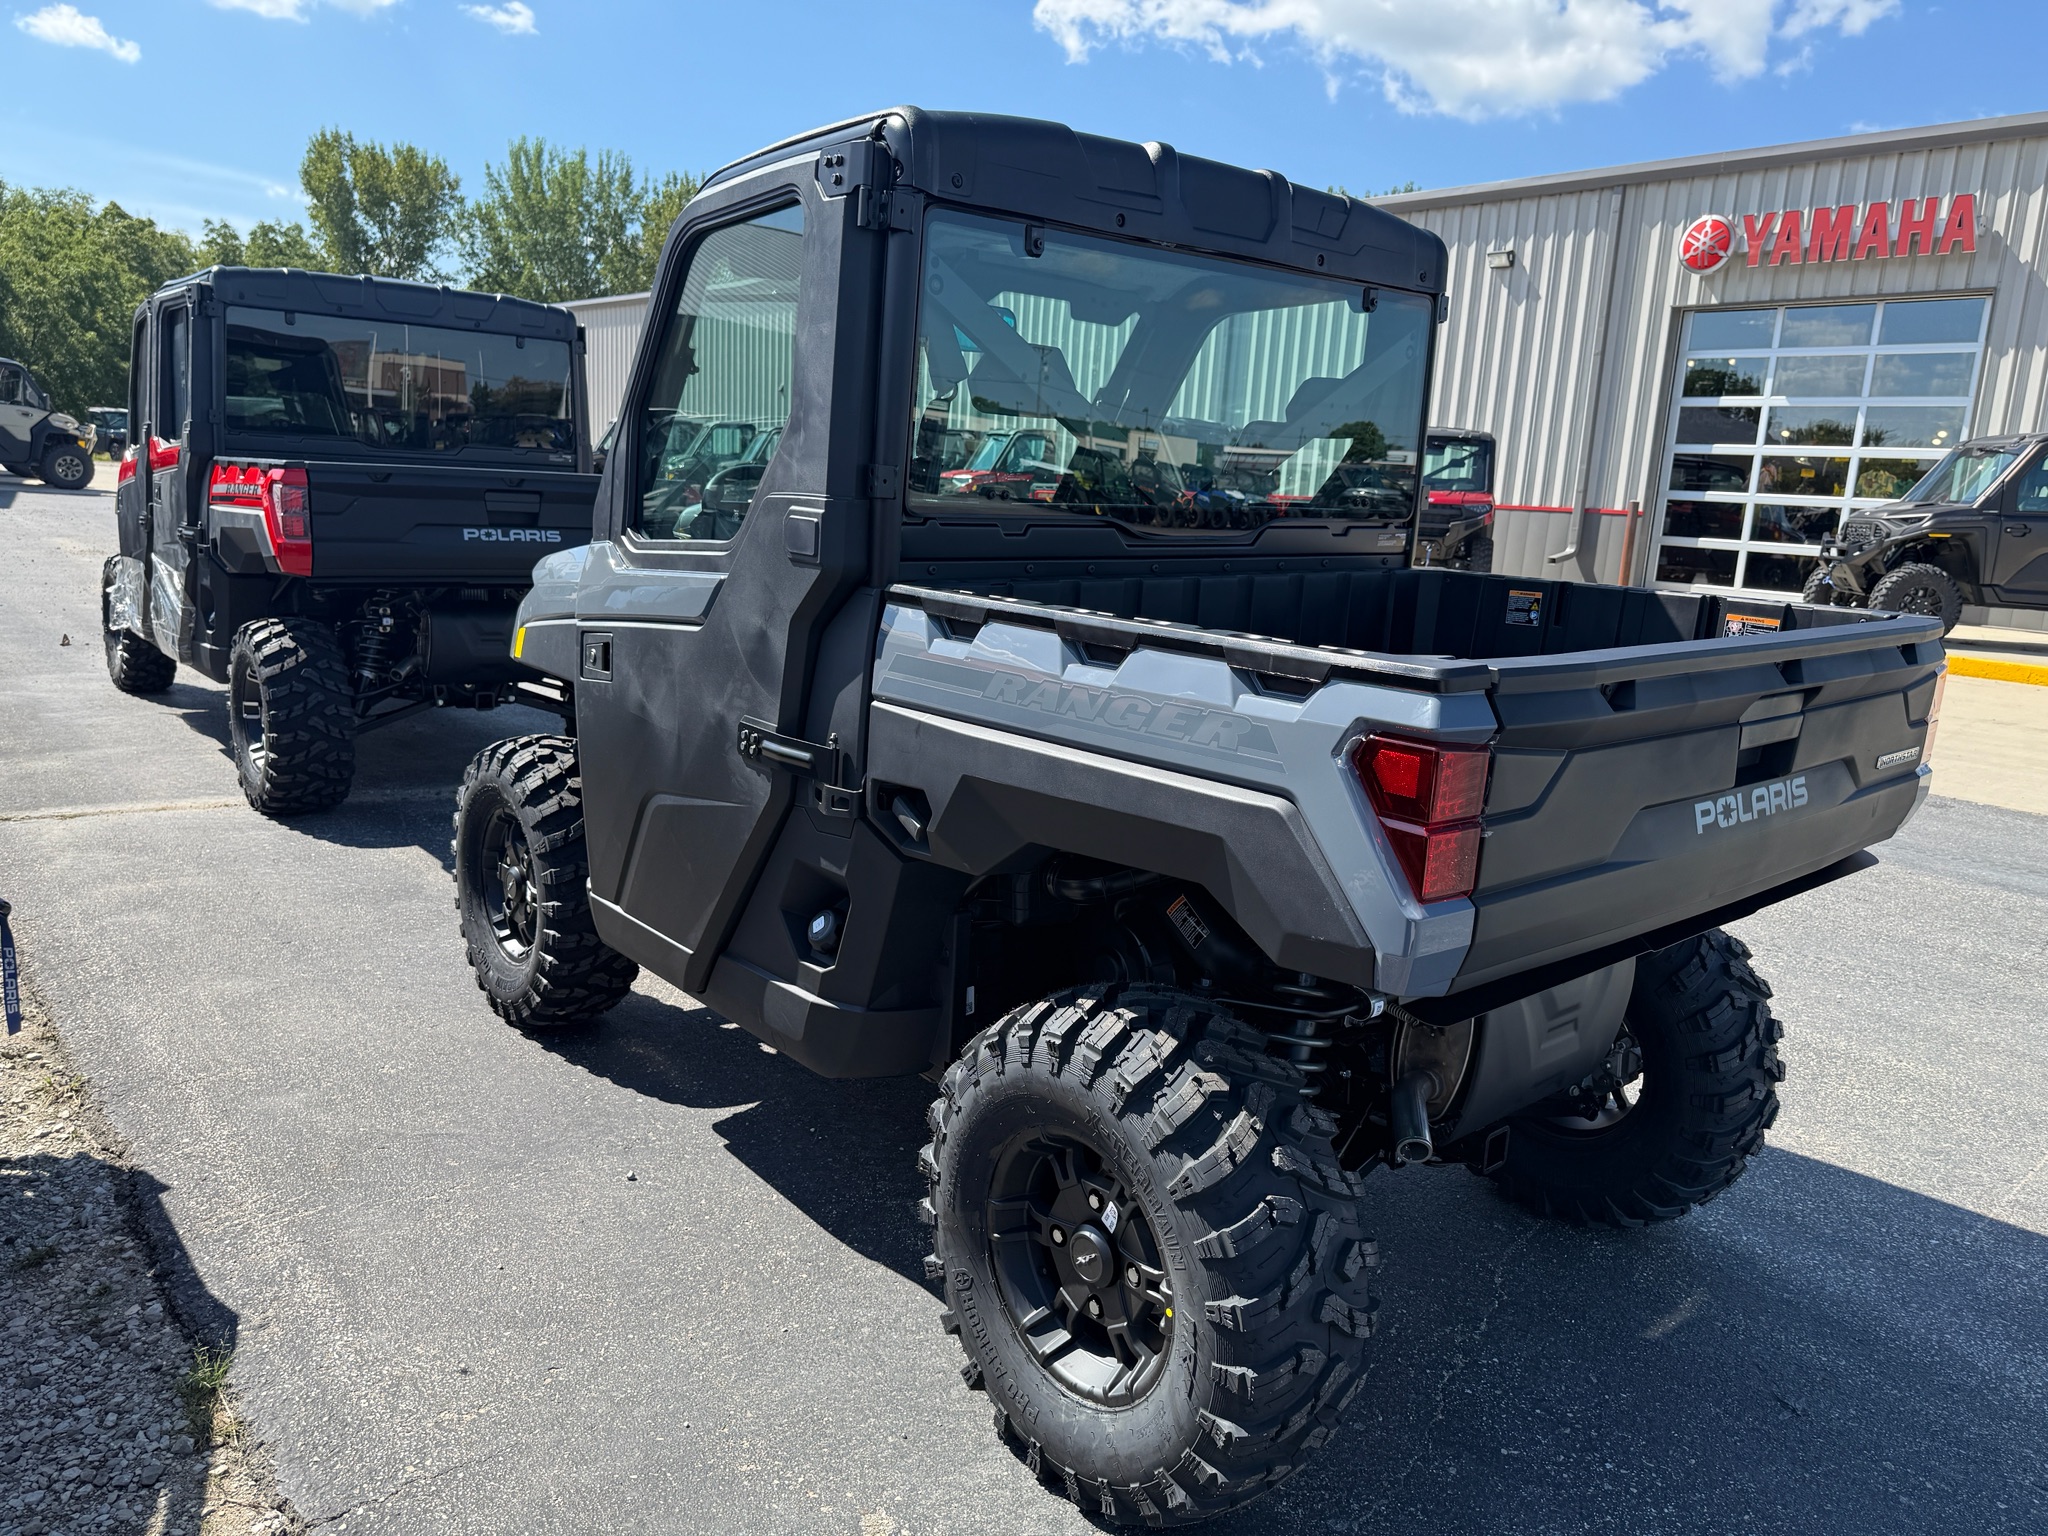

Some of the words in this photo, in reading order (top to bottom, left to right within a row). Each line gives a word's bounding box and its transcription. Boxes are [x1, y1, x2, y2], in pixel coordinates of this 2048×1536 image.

[1743, 194, 1976, 268] YAMAHA
[226, 483, 259, 496] RANGER
[463, 528, 562, 543] POLARIS
[982, 669, 1252, 750] RANGER
[1694, 776, 1808, 835] POLARIS
[3, 947, 18, 1014] POLARIS
